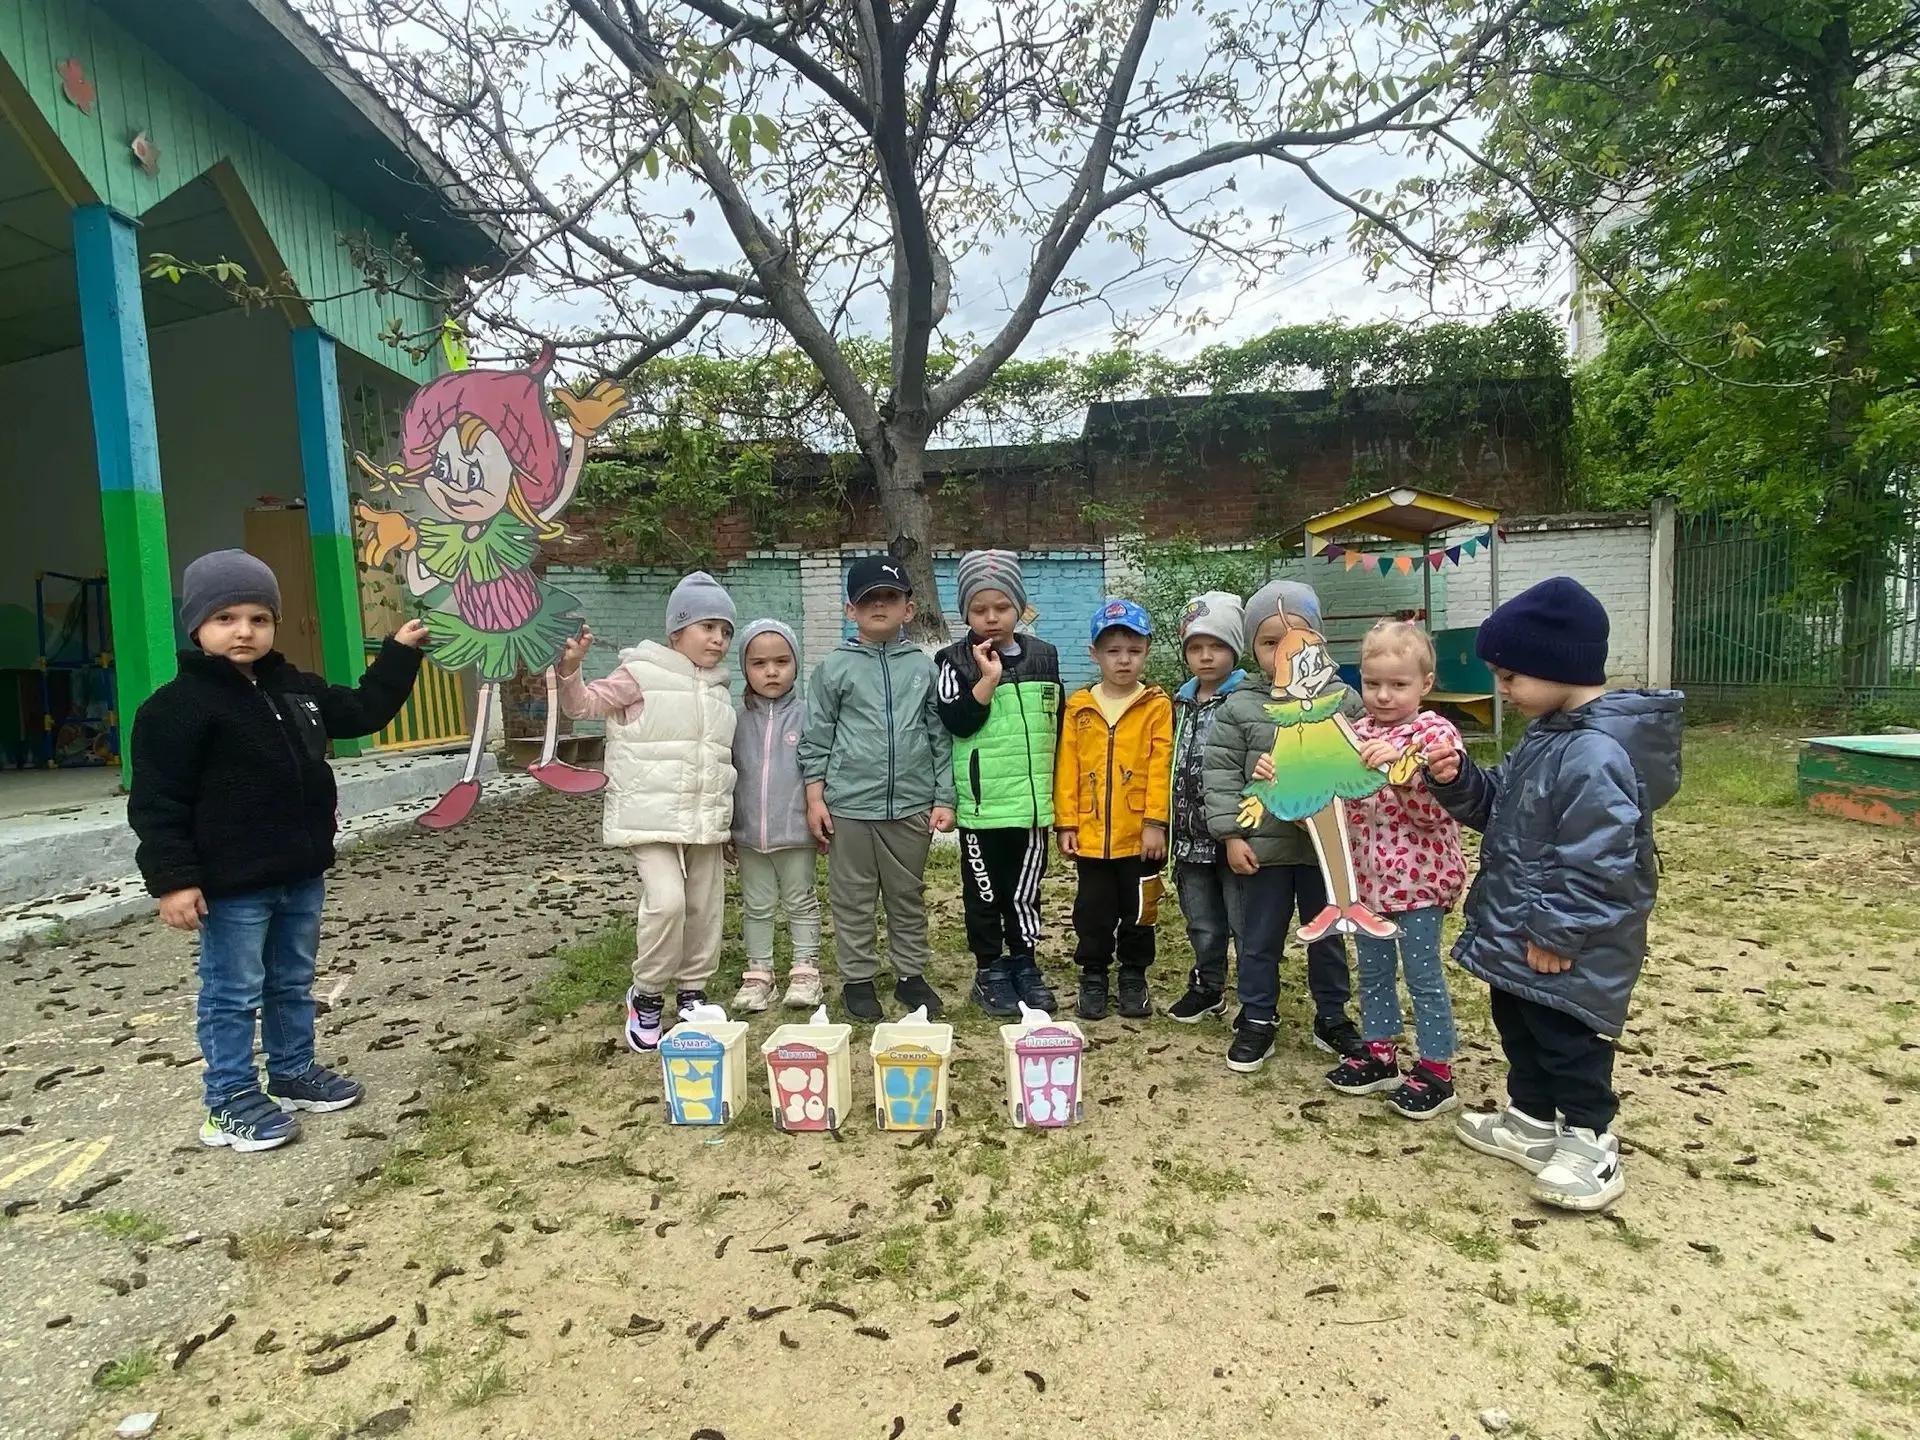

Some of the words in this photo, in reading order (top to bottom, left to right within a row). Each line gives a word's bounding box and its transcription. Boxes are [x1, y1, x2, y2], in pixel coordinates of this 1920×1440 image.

[965, 833, 995, 903] adidas
[673, 1038, 711, 1049] Бумага
[1027, 1037, 1073, 1046] Пластик
[890, 1051, 929, 1060] Стекло
